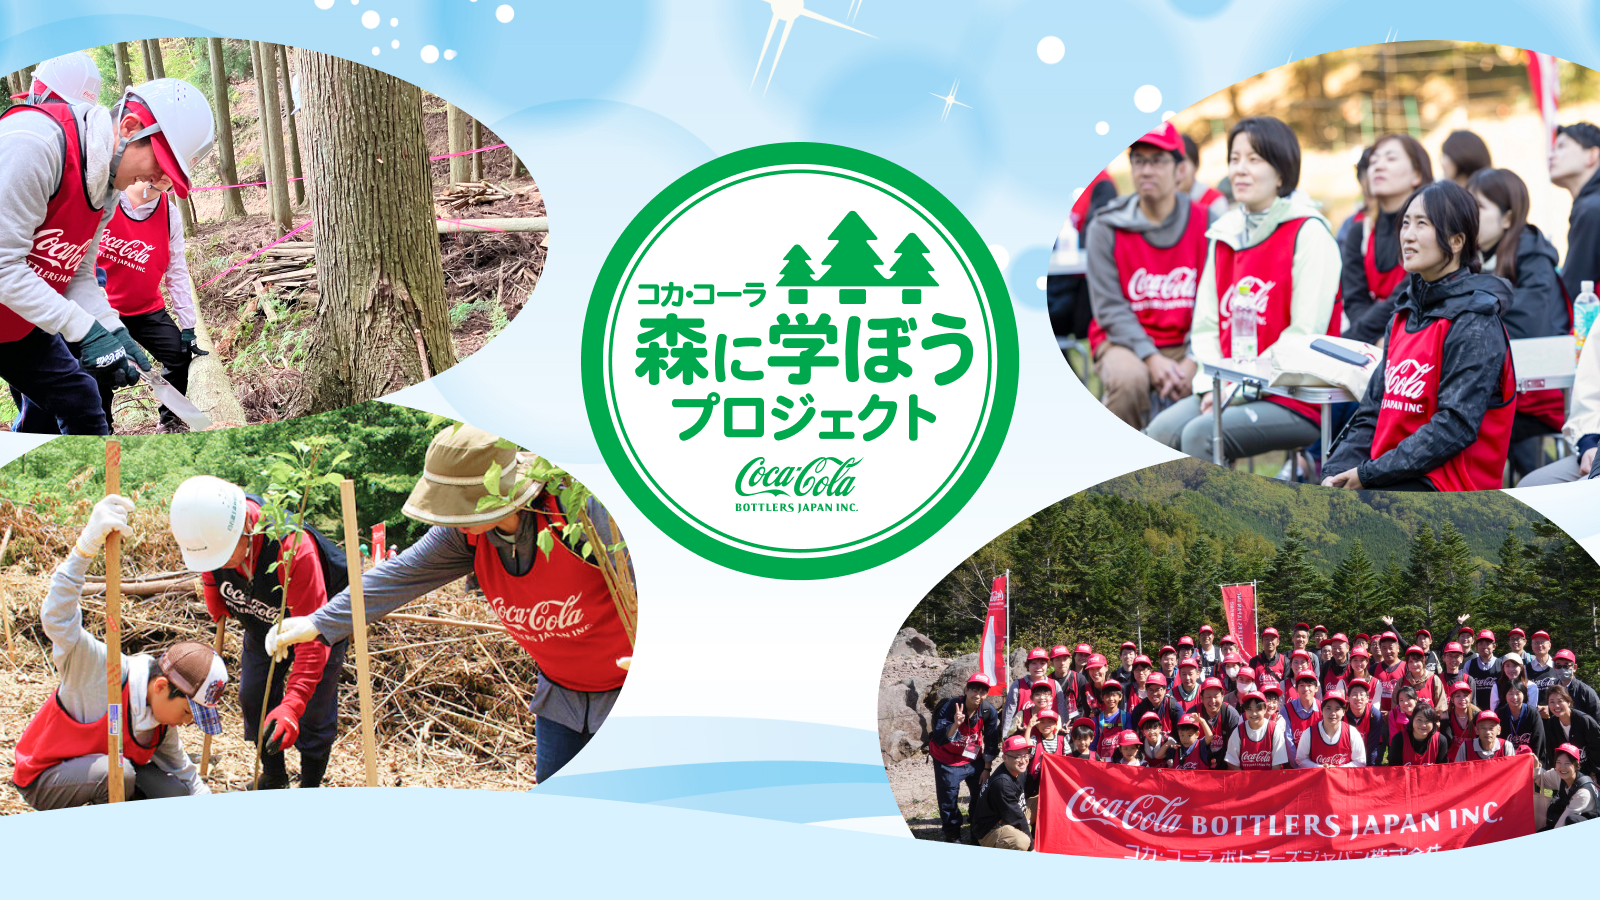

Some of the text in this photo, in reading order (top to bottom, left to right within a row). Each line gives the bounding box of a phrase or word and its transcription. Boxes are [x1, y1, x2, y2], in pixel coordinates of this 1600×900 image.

[27, 259, 72, 283] TTLERS JAP
[1382, 398, 1425, 414] JAPAN INC.
[492, 591, 584, 632] Coca-Cola
[1065, 786, 1503, 841] Coca-Cola BOTTLERS JAPAN INC.
